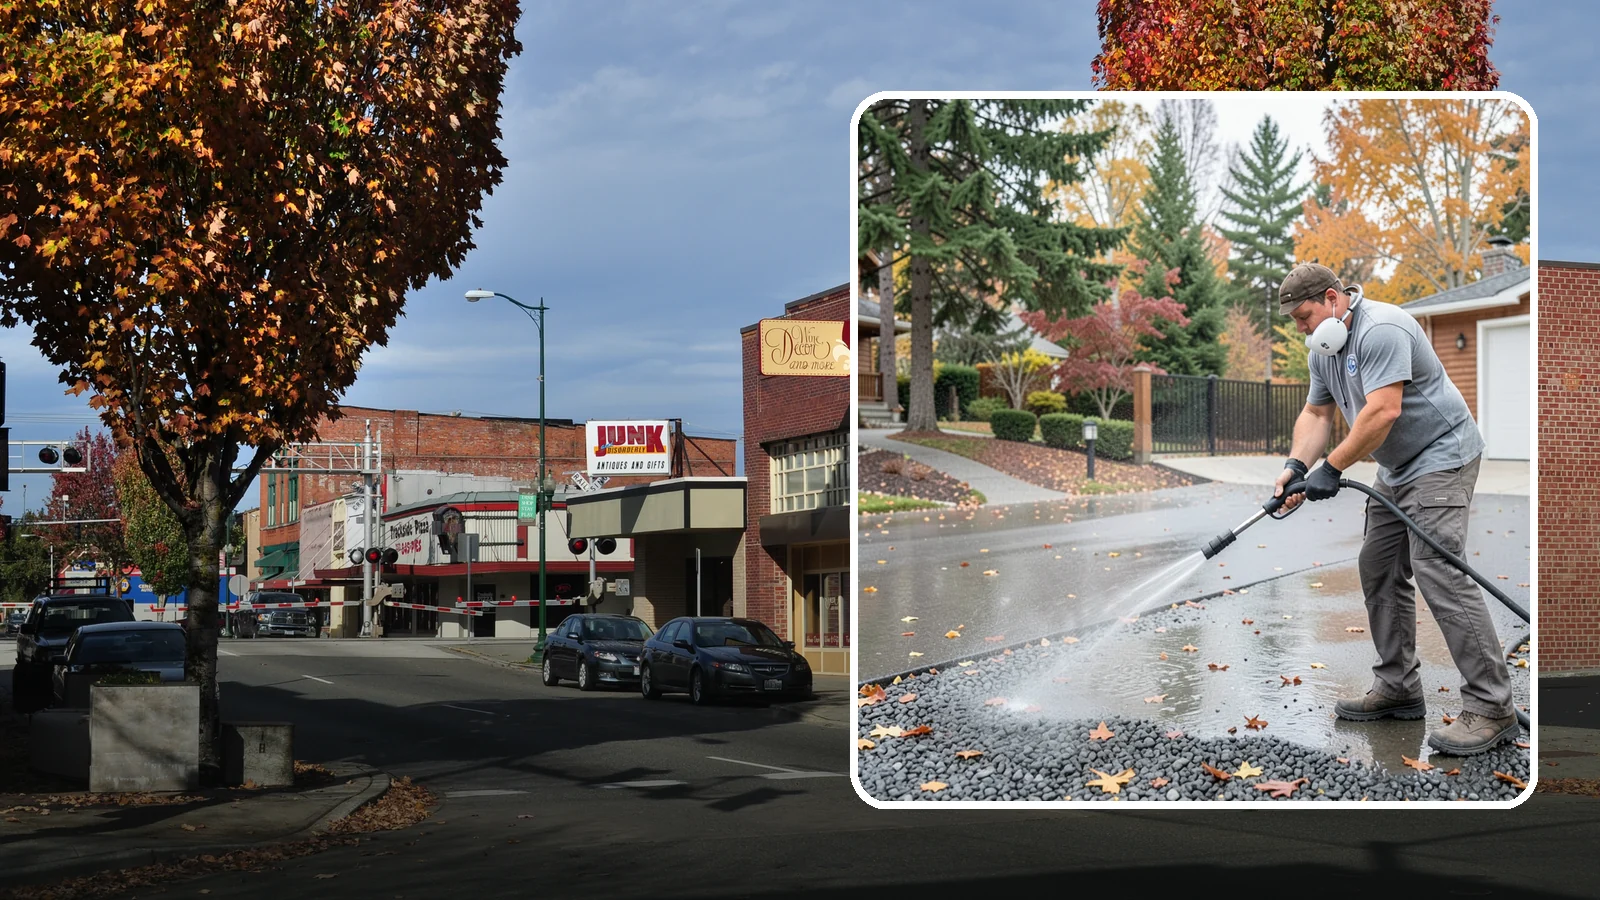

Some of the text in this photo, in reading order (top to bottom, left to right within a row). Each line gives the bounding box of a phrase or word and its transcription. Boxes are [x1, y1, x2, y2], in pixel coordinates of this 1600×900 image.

[791, 325, 823, 344] Wine
[765, 328, 830, 365] Decor
[596, 425, 665, 457] JUNK
[607, 446, 646, 454] DISORDERLY
[597, 460, 665, 470] ANTIQUES AND GIFTS
[352, 498, 364, 511] CRO
[414, 520, 429, 535] Pizza
